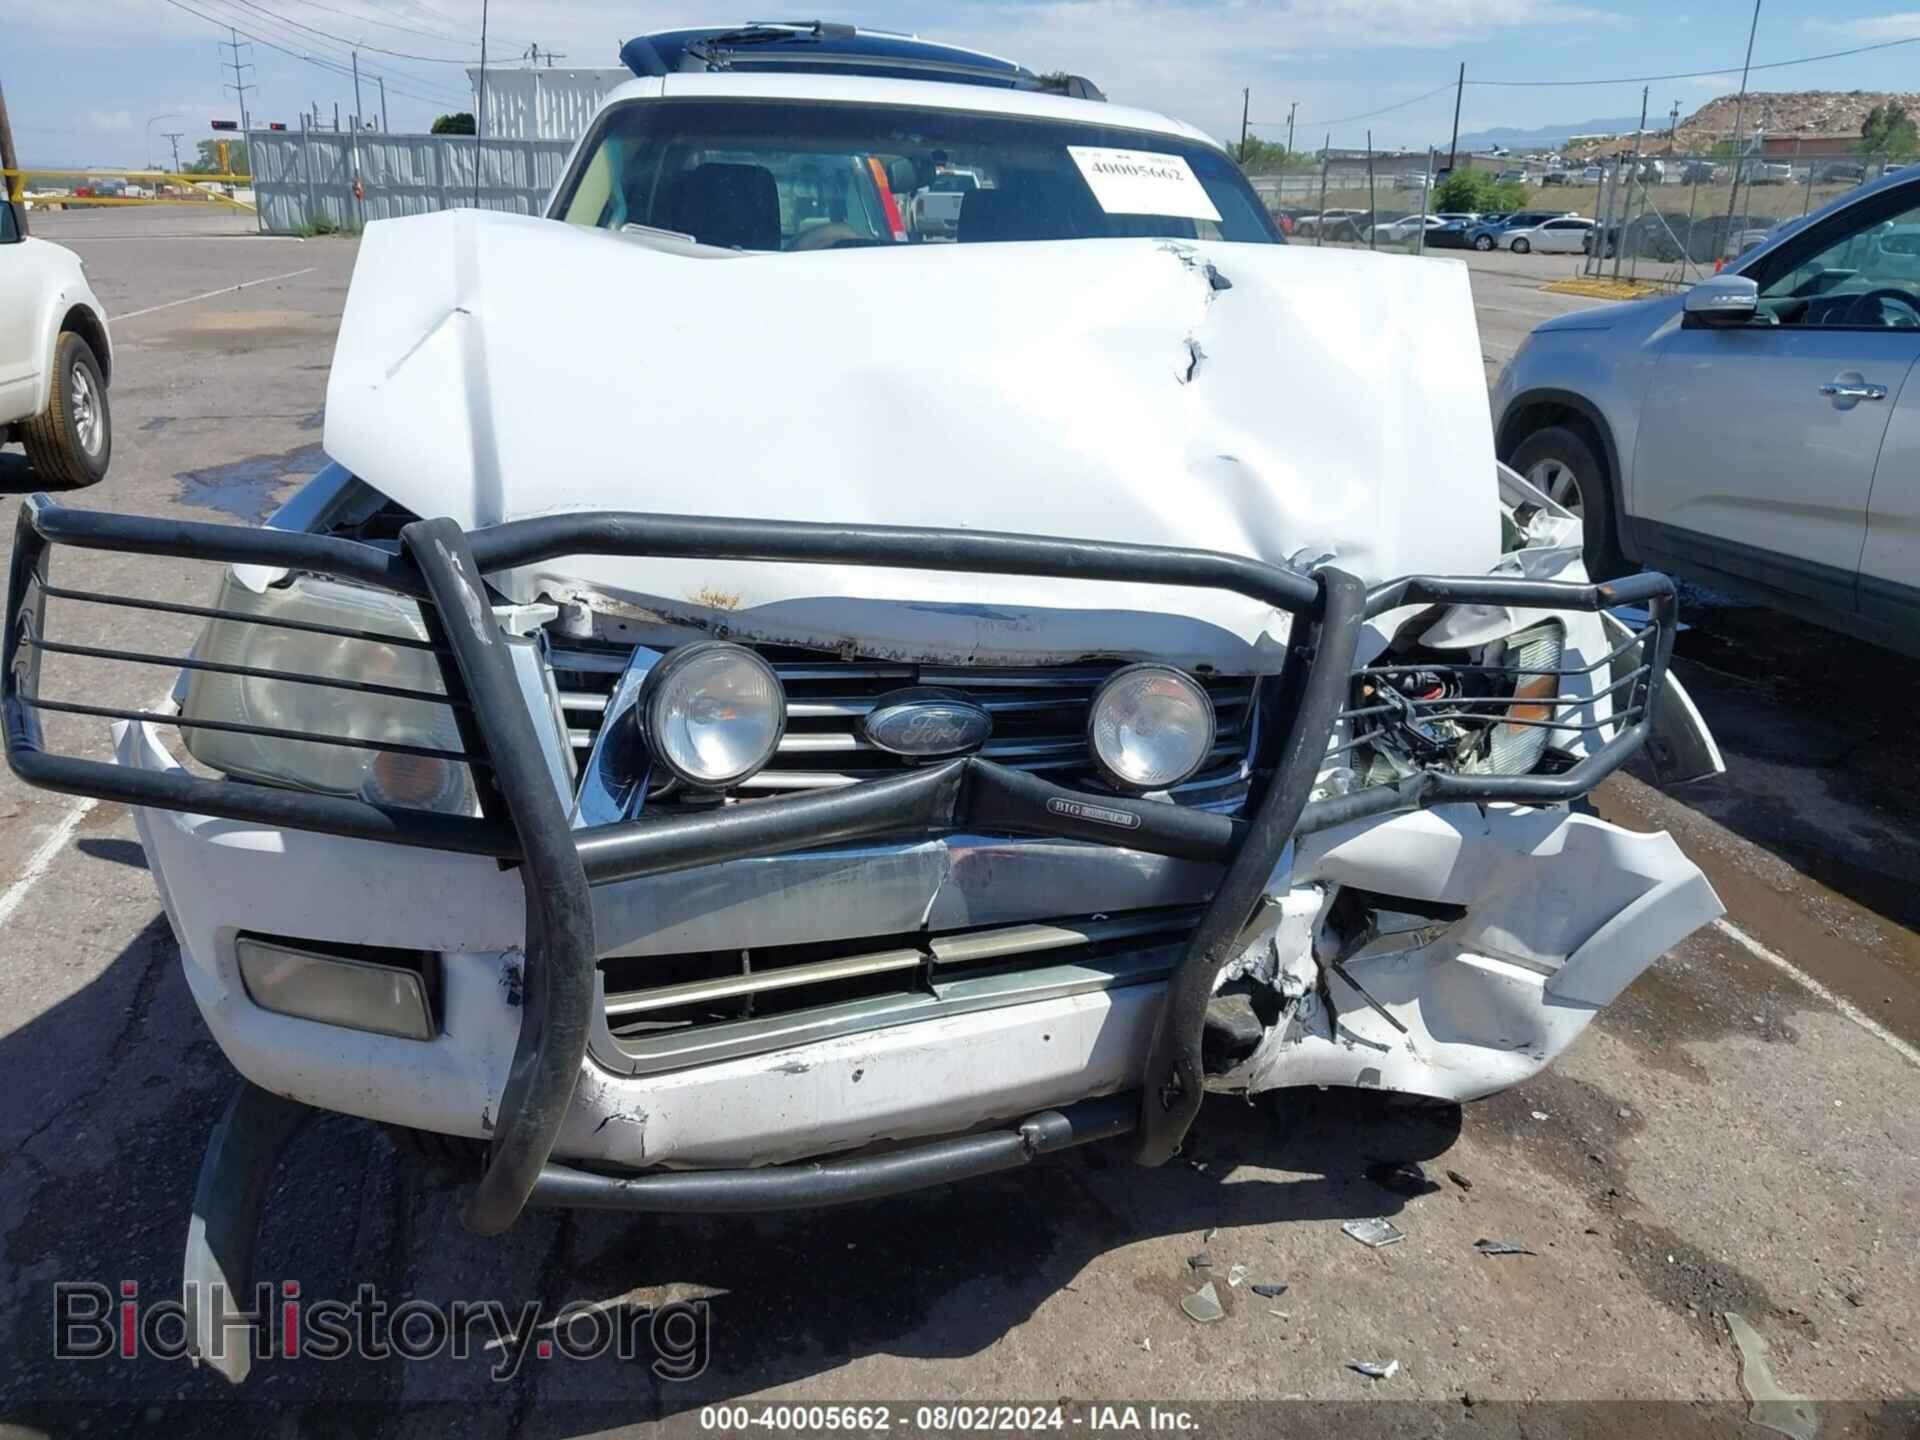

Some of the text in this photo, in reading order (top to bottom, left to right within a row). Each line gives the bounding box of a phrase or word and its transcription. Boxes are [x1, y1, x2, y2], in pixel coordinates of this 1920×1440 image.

[1092, 161, 1185, 181] 40005662
[900, 712, 969, 744] Ford
[1055, 801, 1080, 815] BIG
